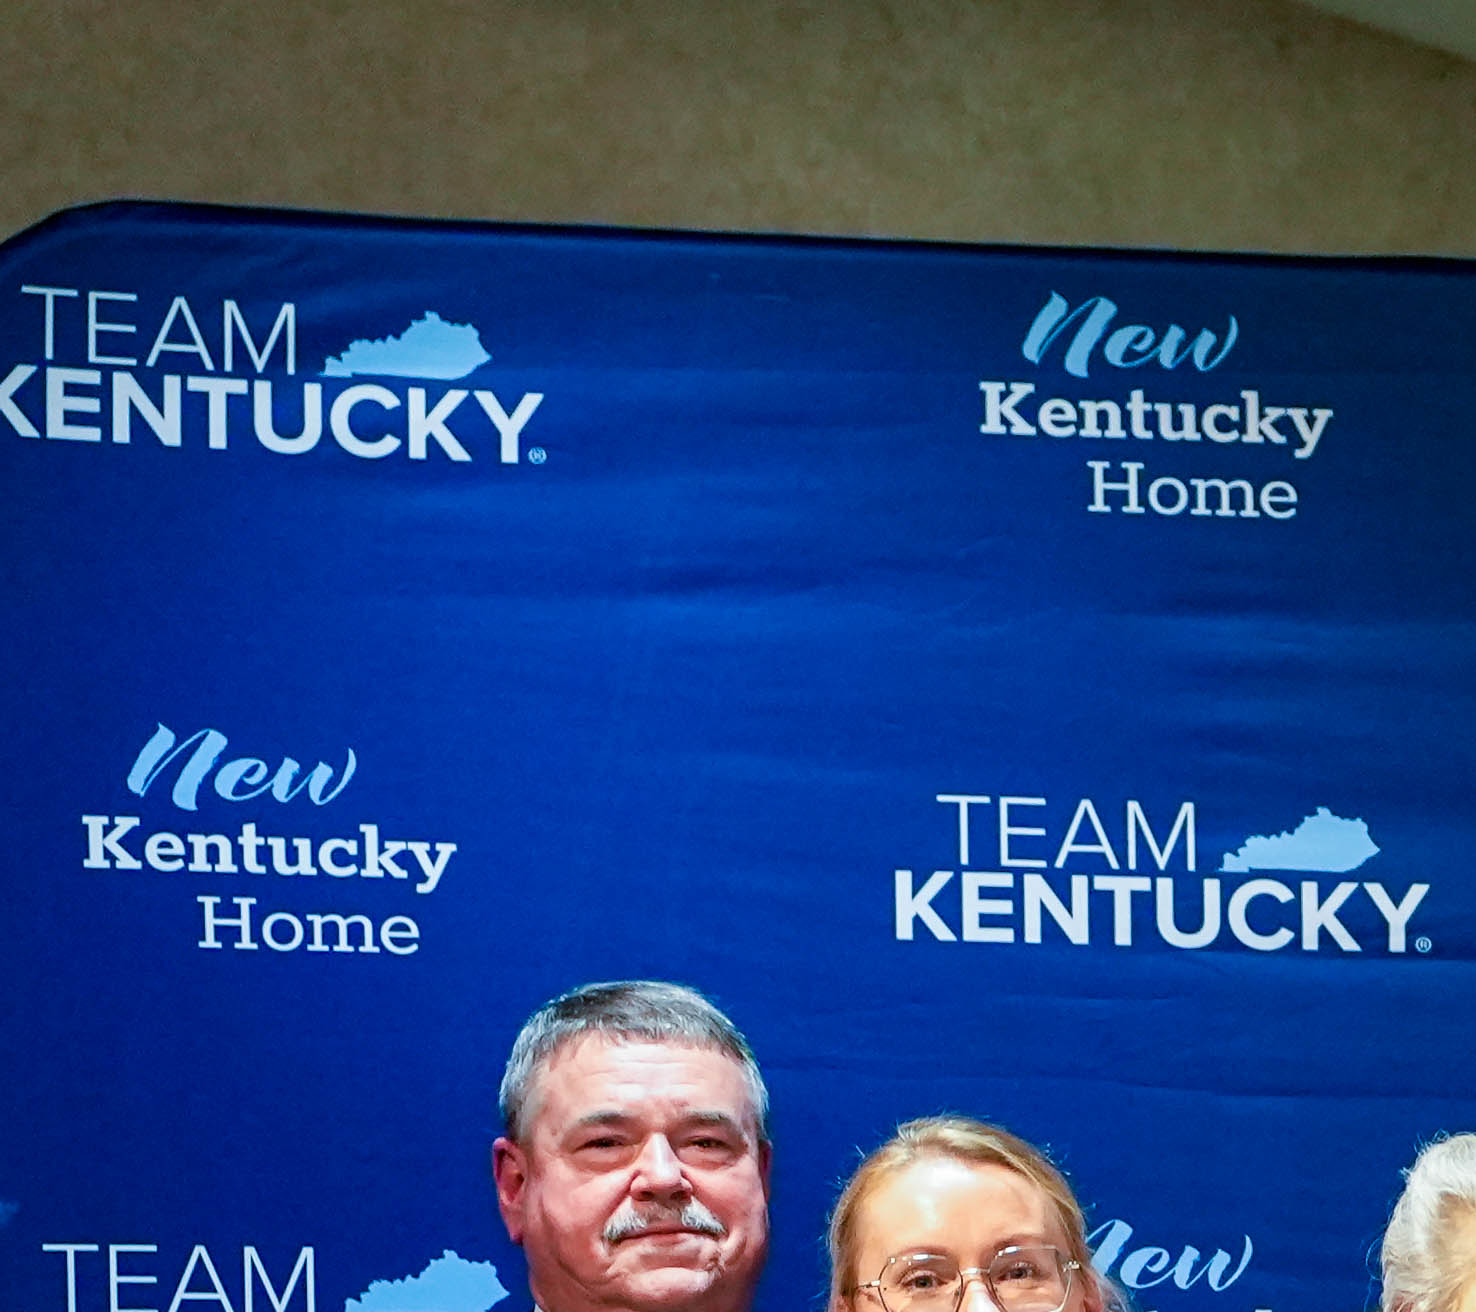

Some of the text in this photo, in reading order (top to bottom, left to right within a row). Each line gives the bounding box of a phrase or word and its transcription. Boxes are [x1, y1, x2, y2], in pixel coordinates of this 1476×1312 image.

[21, 285, 295, 375] TEAM
[1023, 290, 1238, 378] New
[979, 381, 1334, 459] Kentucky
[1086, 460, 1298, 519] Home
[127, 722, 356, 811] New
[82, 815, 457, 894] Kentucky
[936, 794, 1196, 872] TEAM
[197, 895, 420, 955] Home
[895, 870, 1431, 953] KENTUCKY
